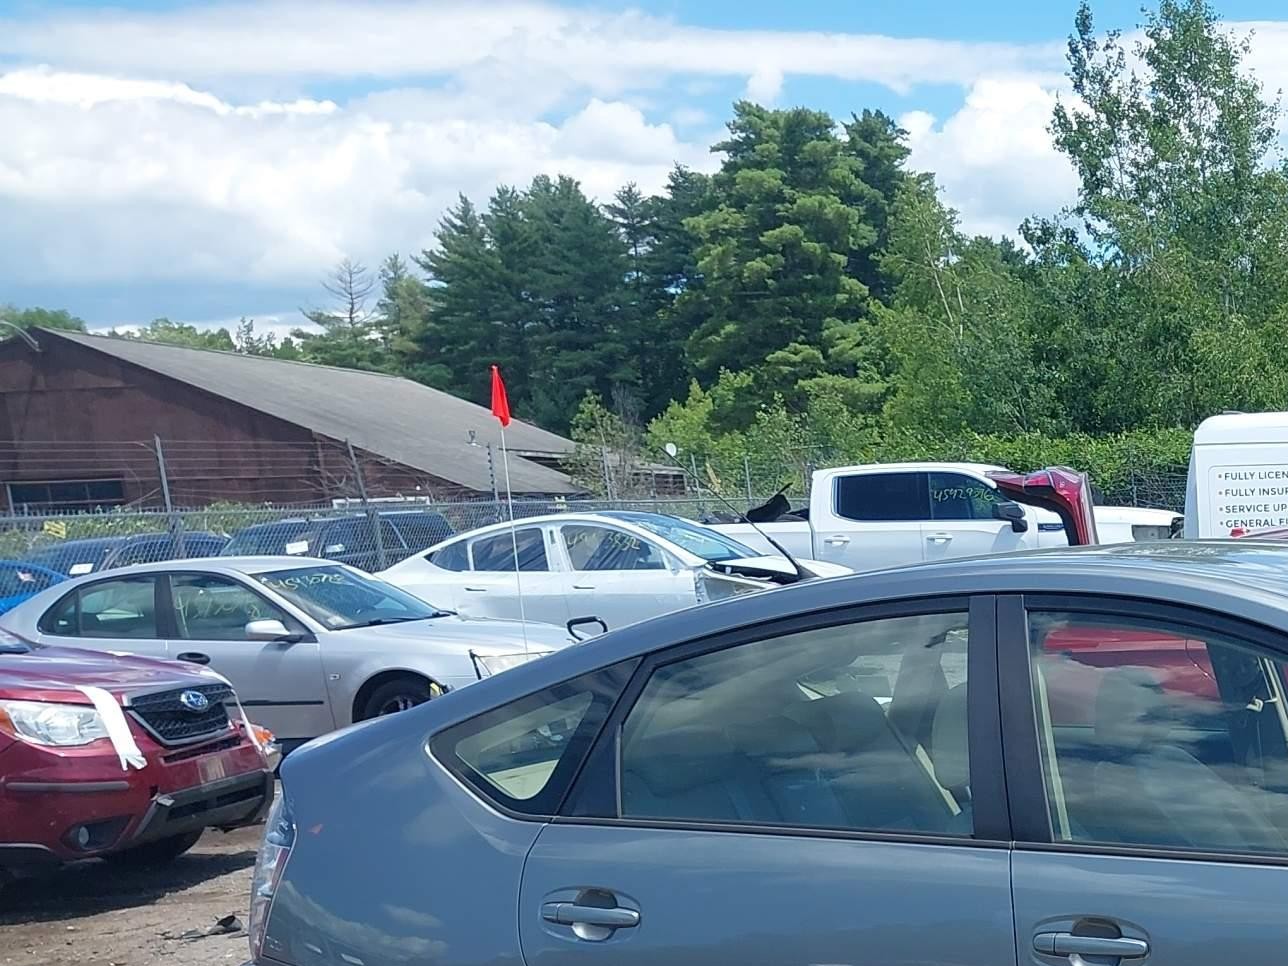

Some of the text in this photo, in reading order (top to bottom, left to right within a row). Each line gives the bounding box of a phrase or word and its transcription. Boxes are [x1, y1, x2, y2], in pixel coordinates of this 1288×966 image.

[1224, 471, 1255, 481] FULLY
[1224, 488, 1256, 497] FULLY
[1225, 504, 1270, 513] SERVICE
[1225, 518, 1275, 528] GENERAL
